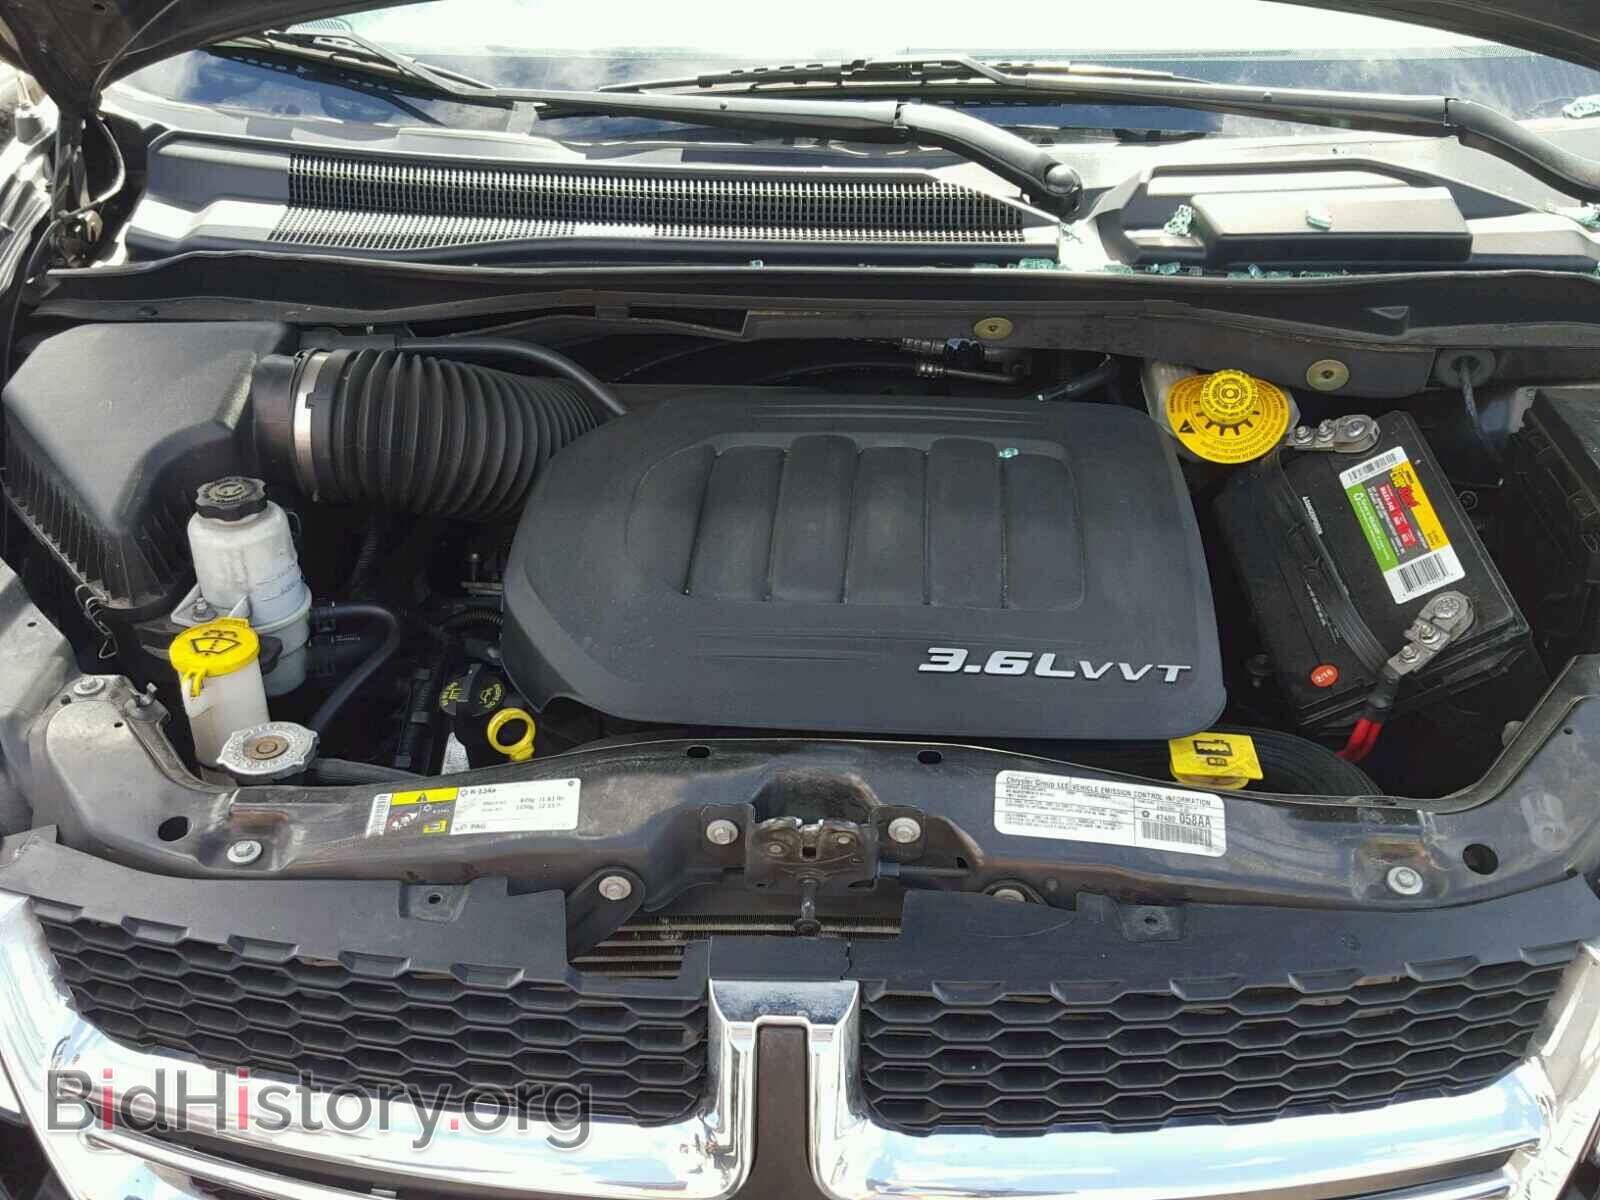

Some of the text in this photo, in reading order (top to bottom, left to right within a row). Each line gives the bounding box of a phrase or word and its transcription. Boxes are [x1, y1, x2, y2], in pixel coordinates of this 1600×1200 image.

[1071, 784, 1099, 793] VEHICLE
[1100, 786, 1132, 797] EMISSION
[1133, 790, 1164, 801] CONTROL
[1165, 794, 1211, 806] INFORMATION
[1178, 813, 1212, 828] 058AA
